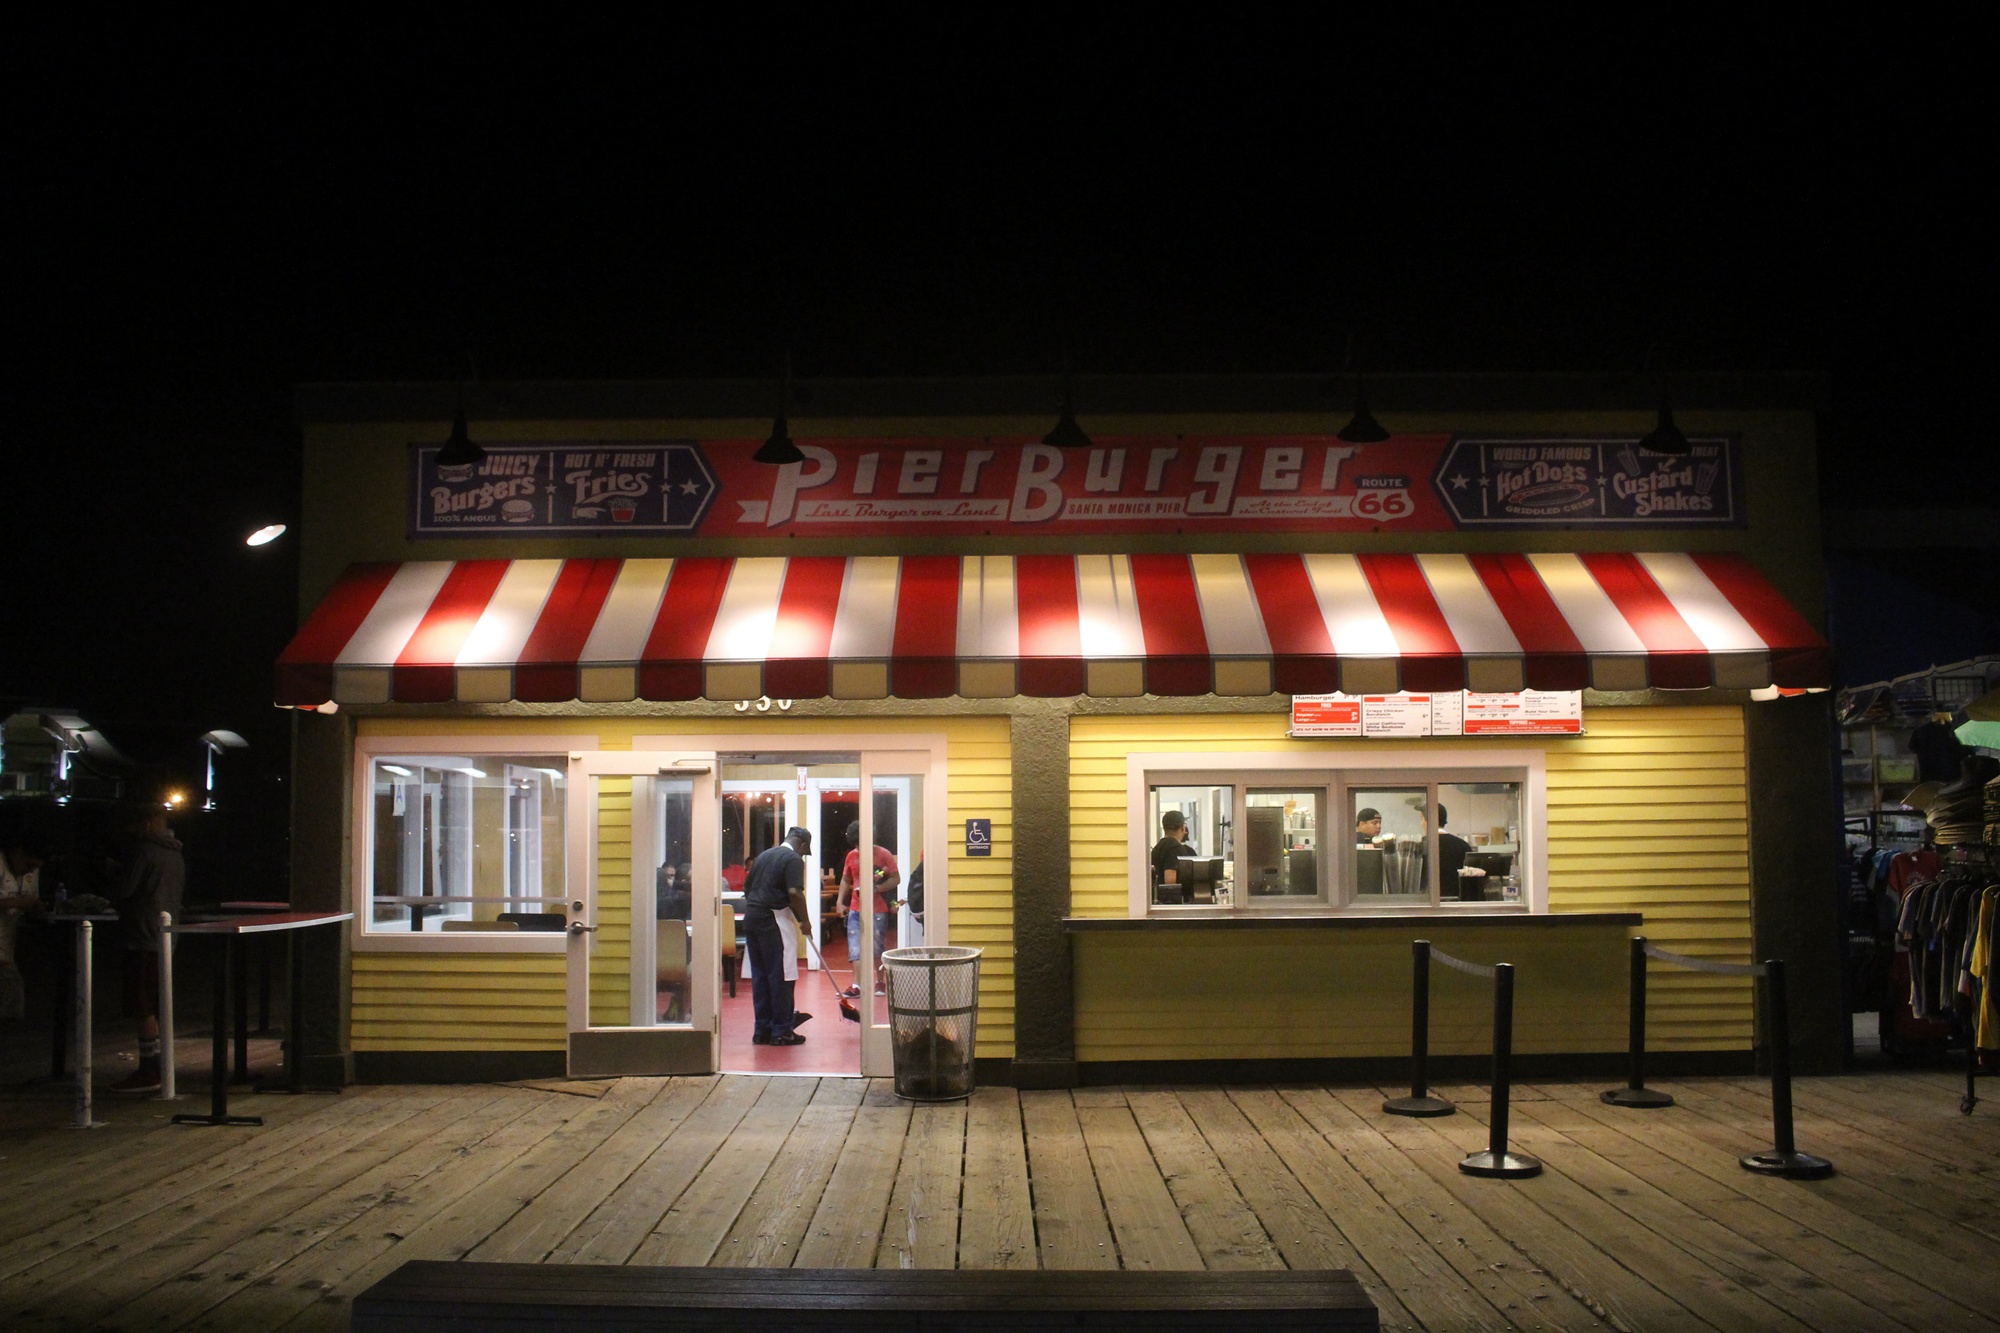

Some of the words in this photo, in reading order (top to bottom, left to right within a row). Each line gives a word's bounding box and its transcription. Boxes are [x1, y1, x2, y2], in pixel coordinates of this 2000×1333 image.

[564, 453, 593, 468] HOT
[613, 453, 656, 467] FRESH
[1493, 447, 1537, 461] WORLD
[1541, 447, 1592, 461] FAMOUS
[478, 454, 540, 476] JUICY
[565, 469, 652, 505] Fries
[766, 445, 995, 528] Pier
[1009, 443, 1364, 523] Burger
[1361, 478, 1403, 487] ROUTE
[1497, 466, 1532, 503] Hot
[1532, 461, 1587, 483] Dogs
[1613, 465, 1693, 499] Custard
[430, 476, 536, 514] Burgers
[1358, 493, 1406, 514] 66
[1634, 490, 1714, 516] Shakes
[433, 515, 460, 523] 100%
[806, 503, 850, 517] Last
[854, 503, 919, 519] Burger
[921, 508, 942, 517] on
[946, 502, 1001, 517] Land
[1068, 503, 1103, 515] SANTA
[1107, 503, 1151, 514] MONICA
[1155, 503, 1181, 514] PIER
[1505, 504, 1561, 516] GRIDDLED
[395, 784, 403, 803] A
